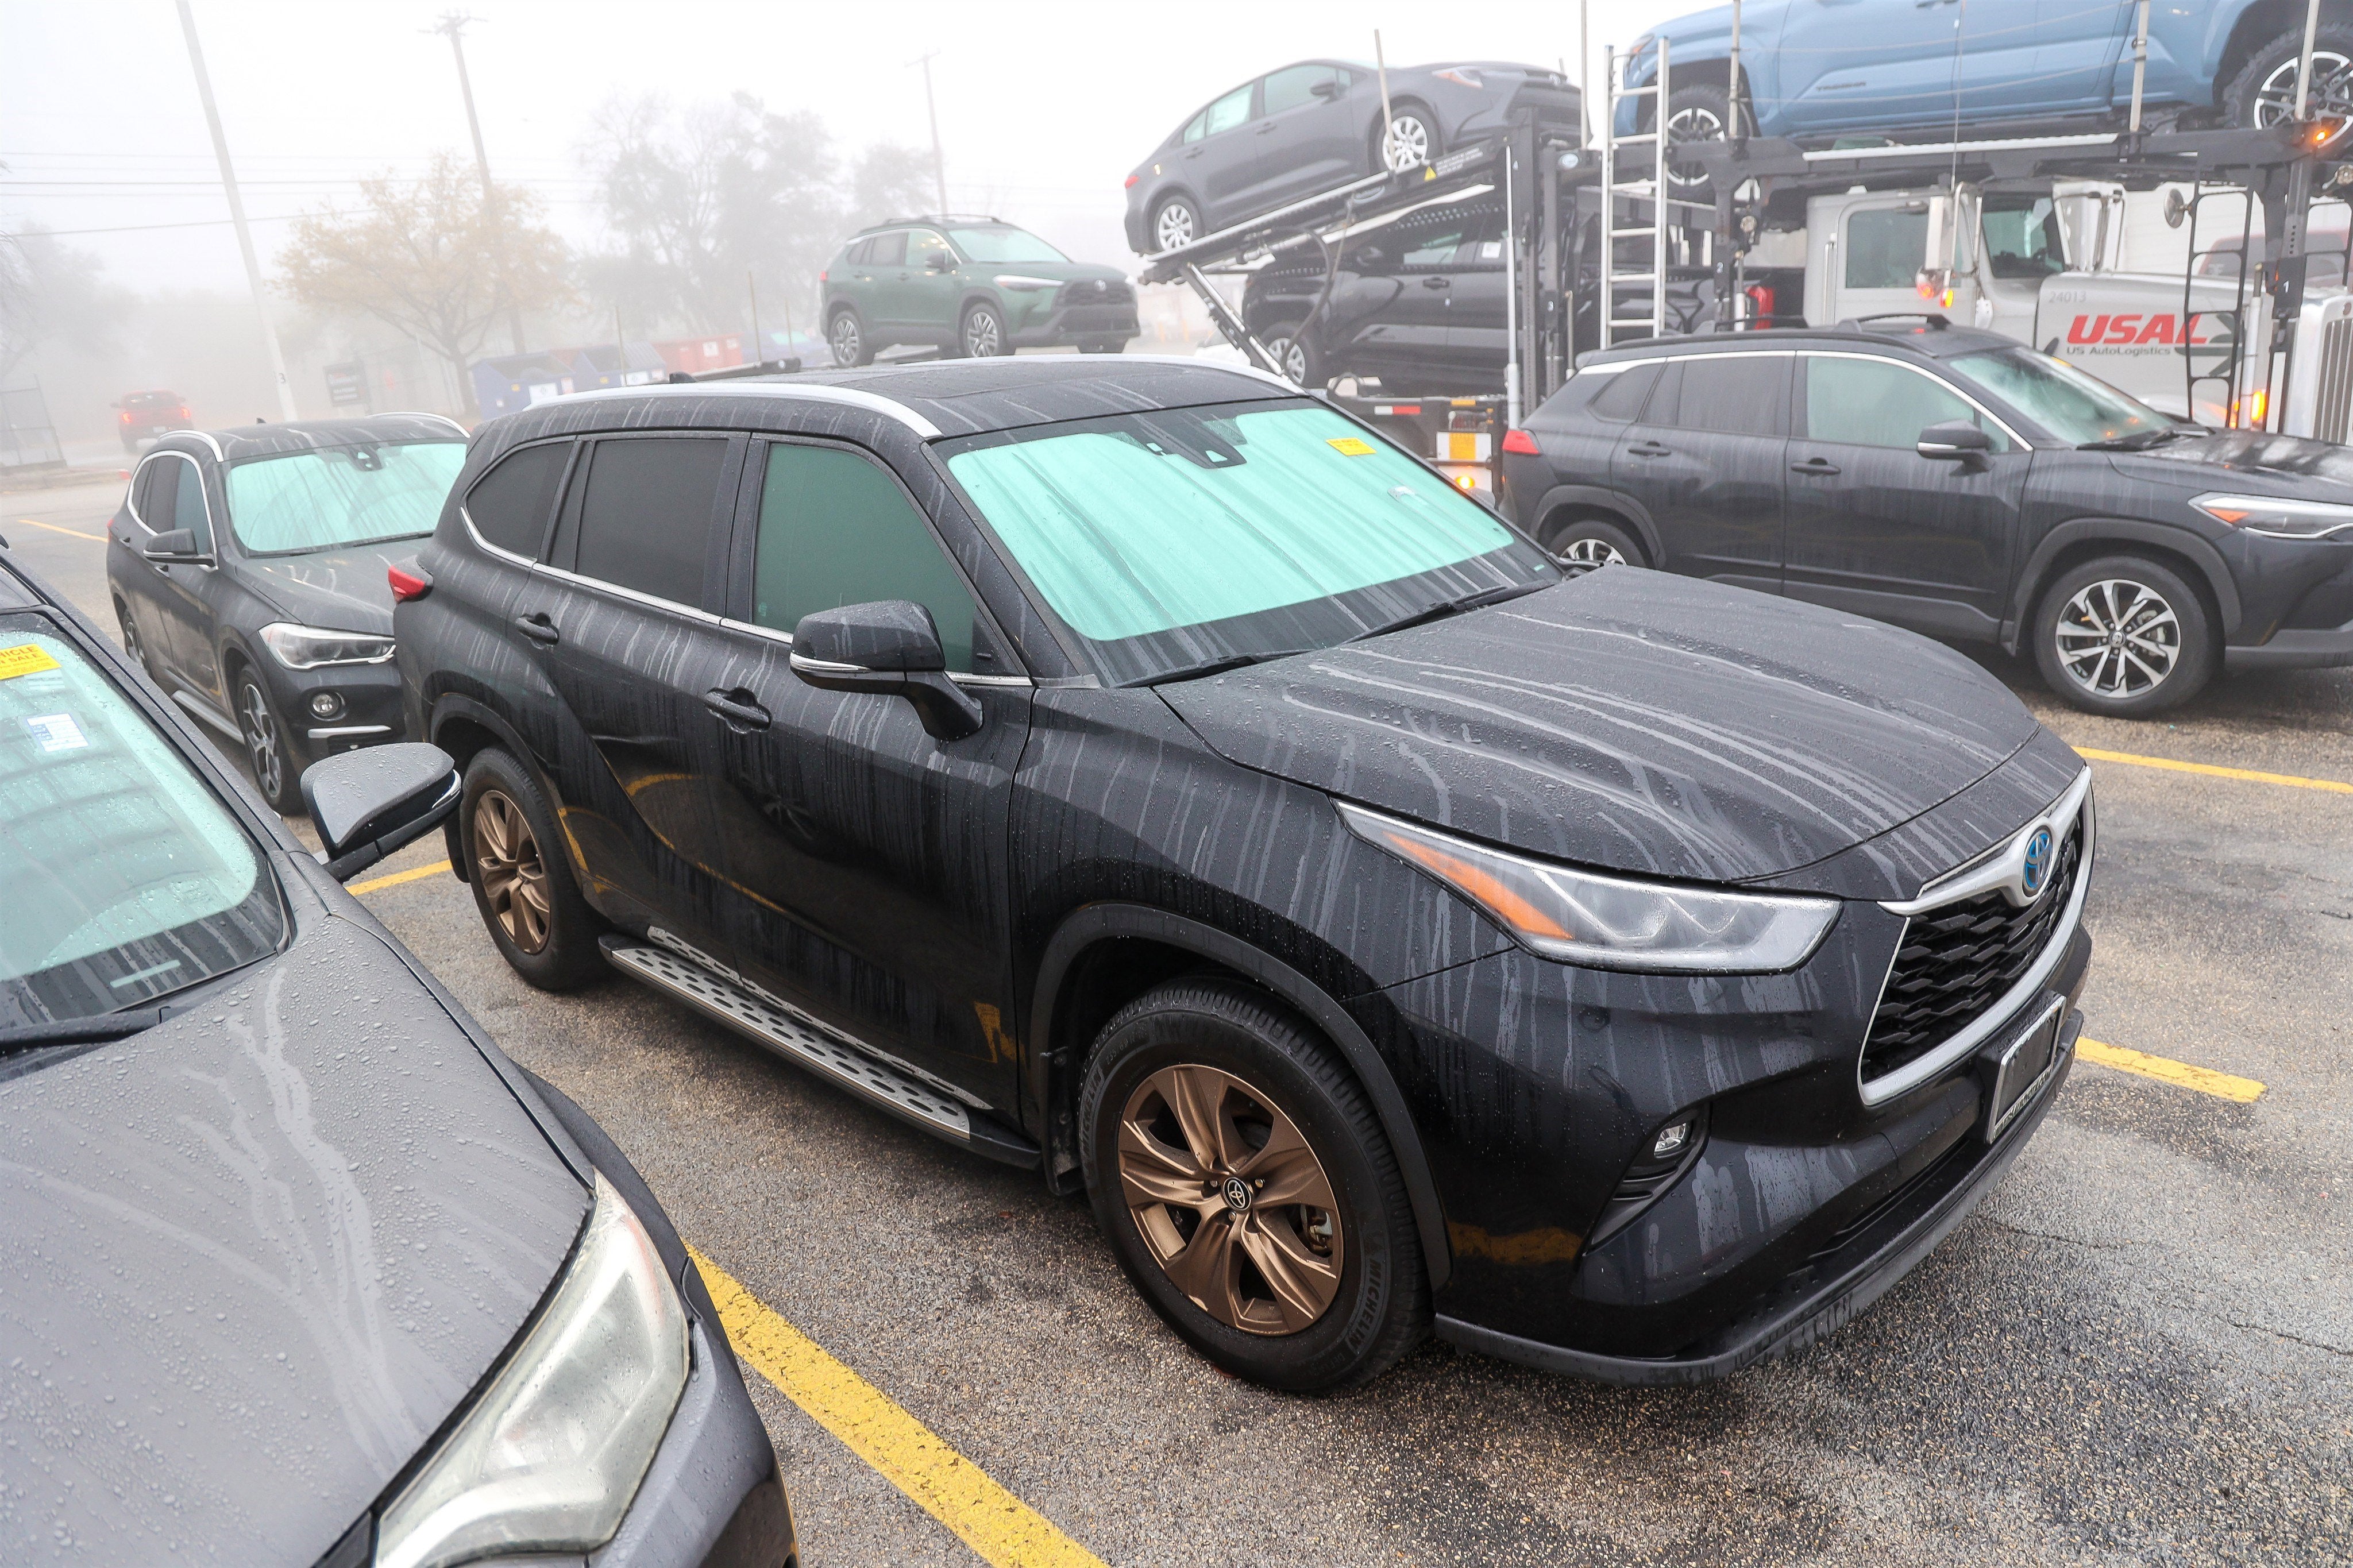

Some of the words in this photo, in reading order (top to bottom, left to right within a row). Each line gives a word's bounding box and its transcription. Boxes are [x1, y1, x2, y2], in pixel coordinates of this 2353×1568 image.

[2283, 280, 2289, 294] 1
[2049, 291, 2086, 303] 24013
[2067, 314, 2208, 344] USAL
[2067, 346, 2084, 355] US
[2089, 346, 2171, 356] AutoLogistics
[279, 373, 286, 384] 3
[1080, 1068, 1104, 1159] MICHELIN
[1348, 1258, 1382, 1350] MICHELIN
